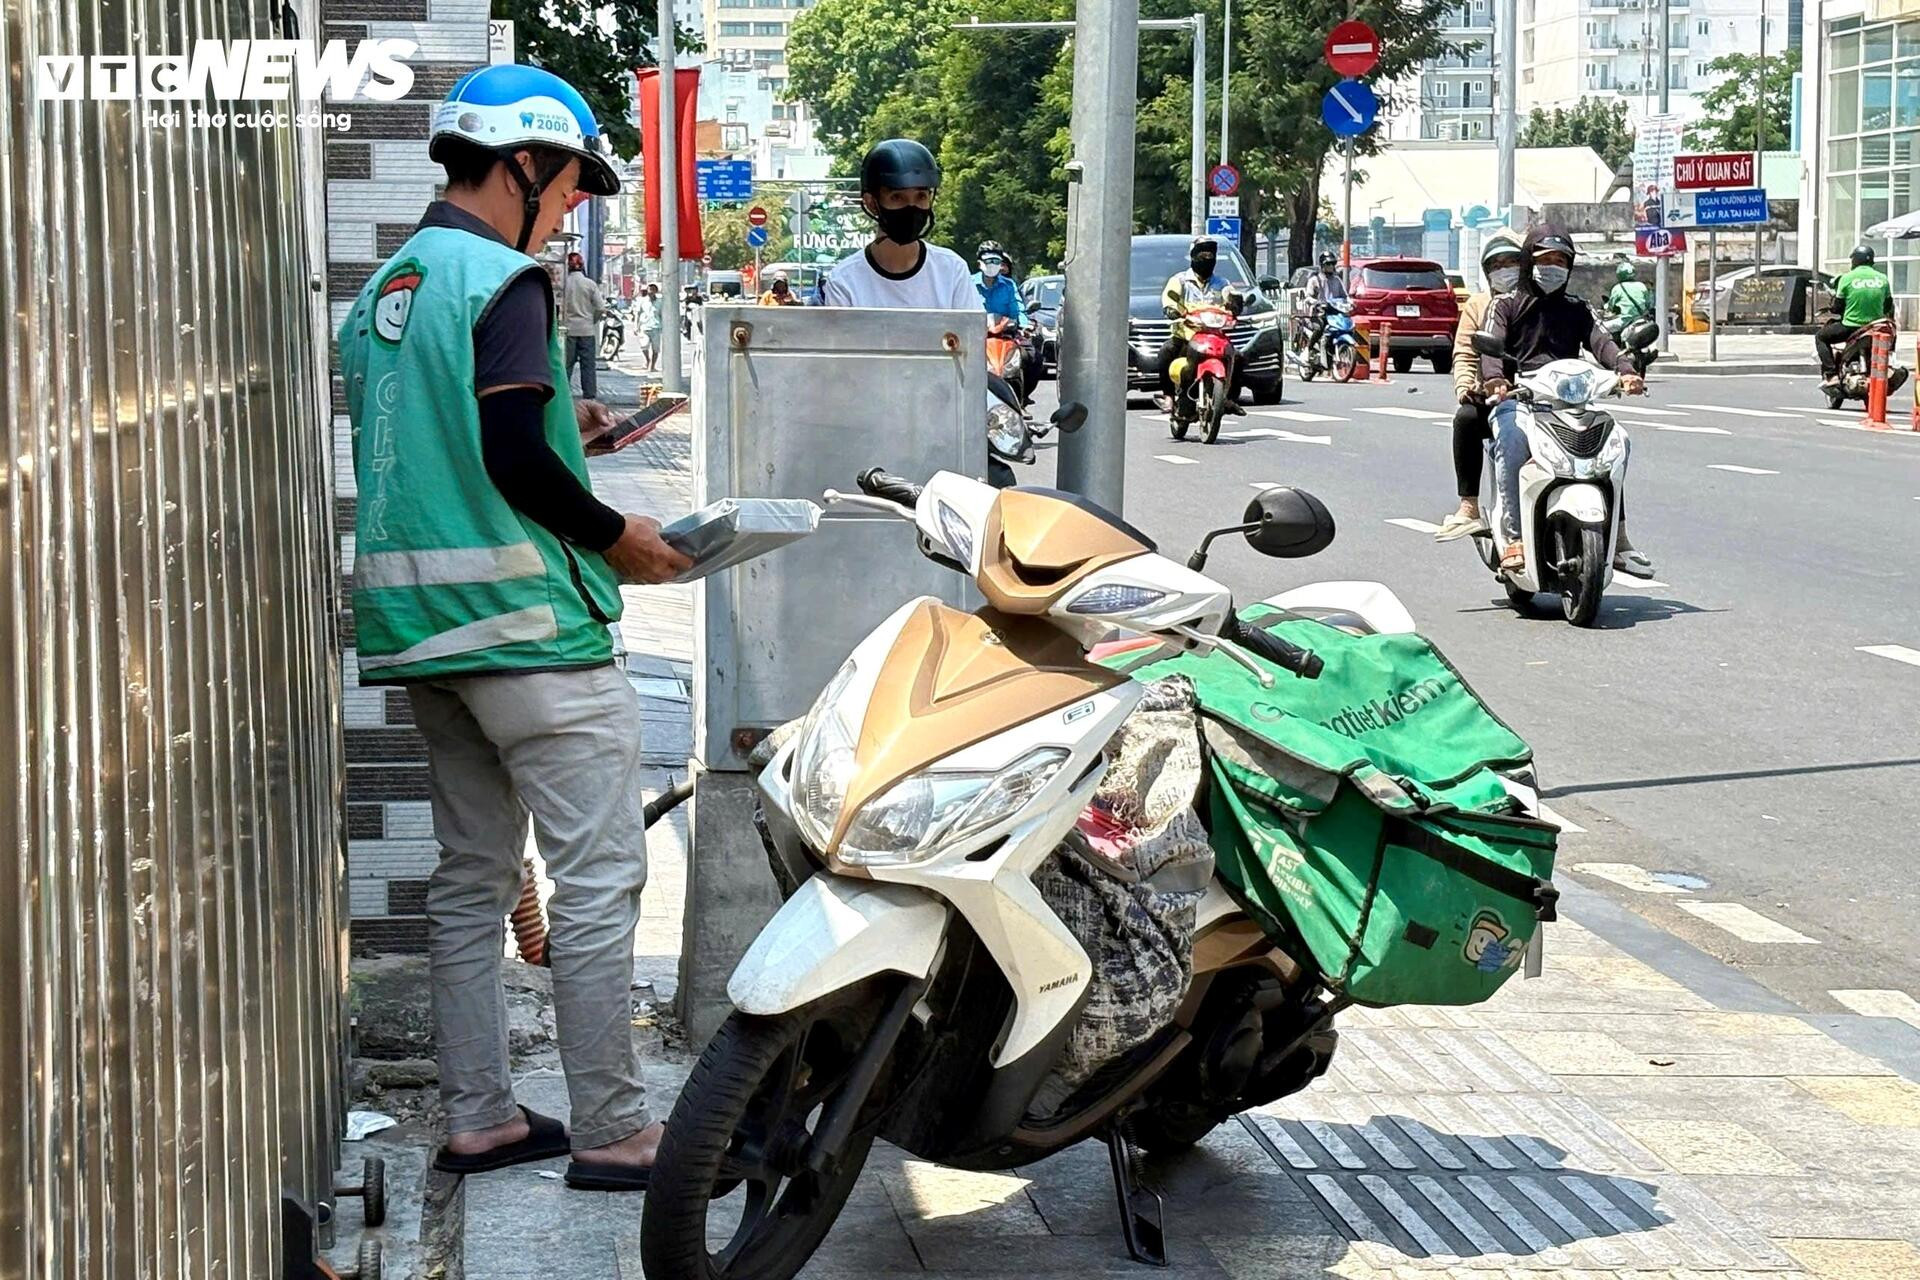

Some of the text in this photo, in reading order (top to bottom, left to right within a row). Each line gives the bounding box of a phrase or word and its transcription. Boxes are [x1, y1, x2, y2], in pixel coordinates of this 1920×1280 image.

[537, 119, 569, 133] 2000
[1676, 157, 1751, 182] CHÚ Ý QUAN SÁT
[1748, 194, 1763, 203] HAY
[1718, 209, 1729, 218] RA
[1852, 276, 1884, 289] Grab
[1039, 972, 1078, 994] YAMAHA
